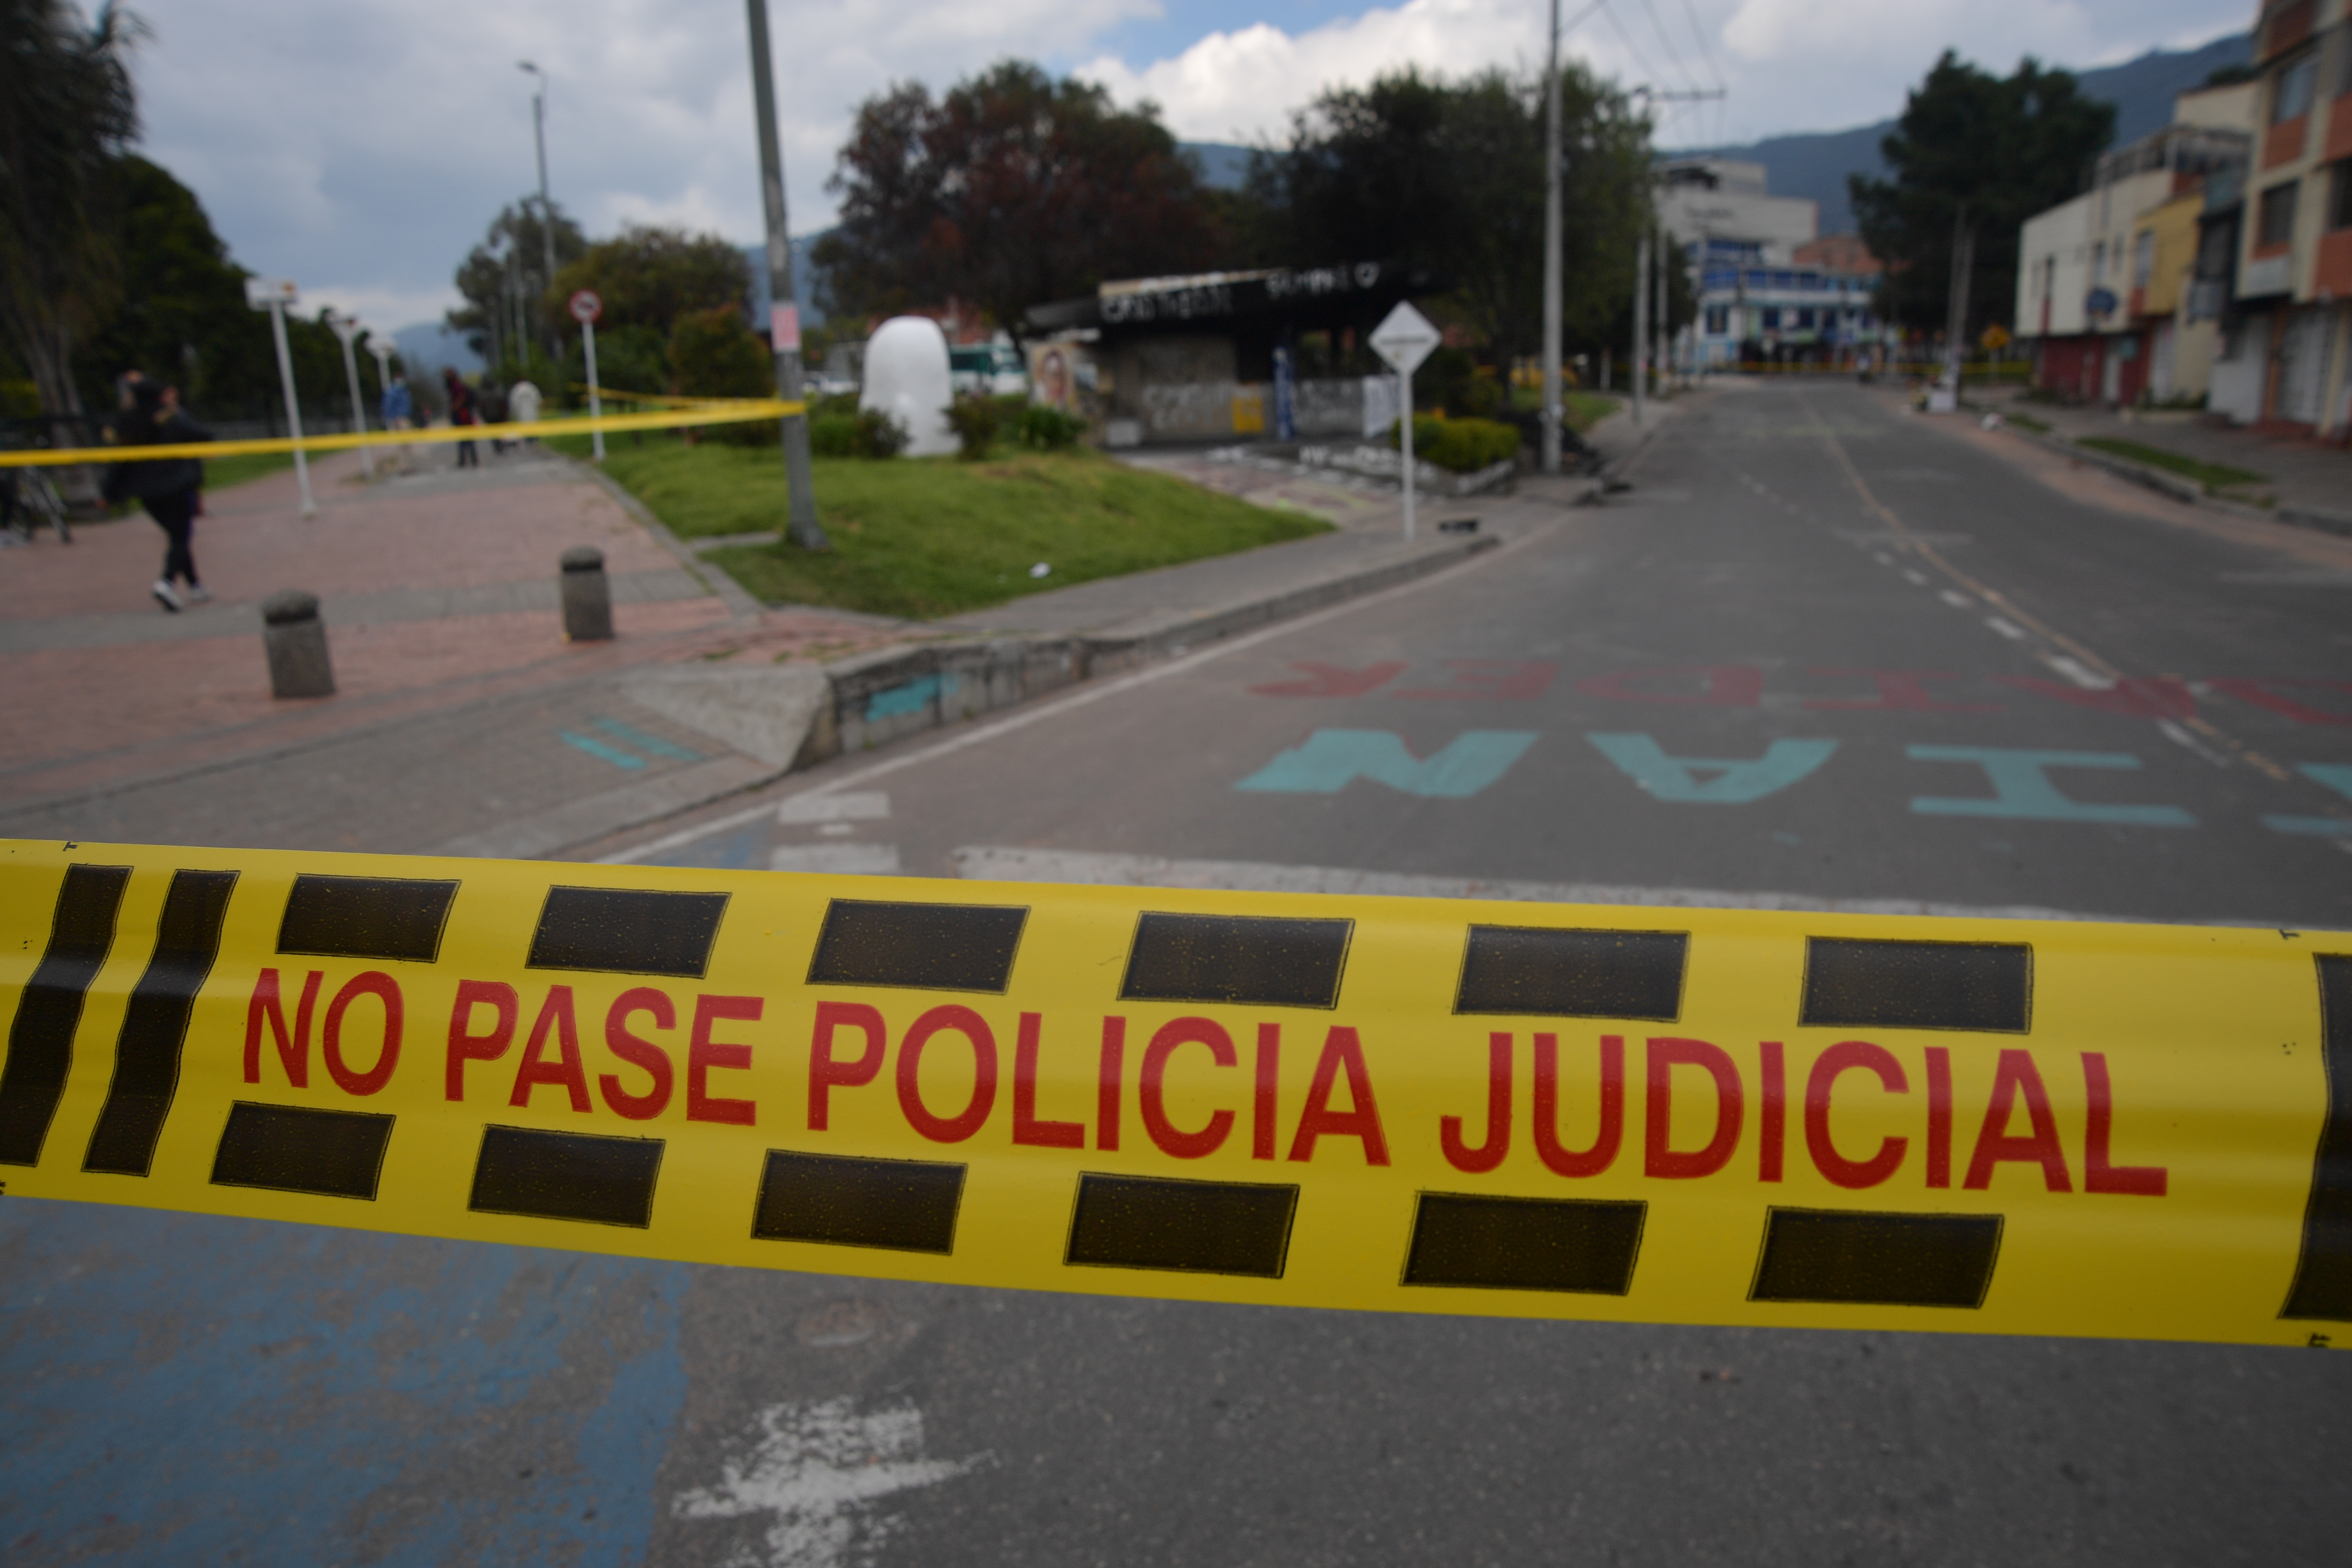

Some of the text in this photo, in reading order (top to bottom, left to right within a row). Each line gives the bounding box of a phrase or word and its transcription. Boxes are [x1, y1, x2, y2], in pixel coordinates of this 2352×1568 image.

[243, 966, 2168, 1198] NO PASE POLICIA JUDICIAL
